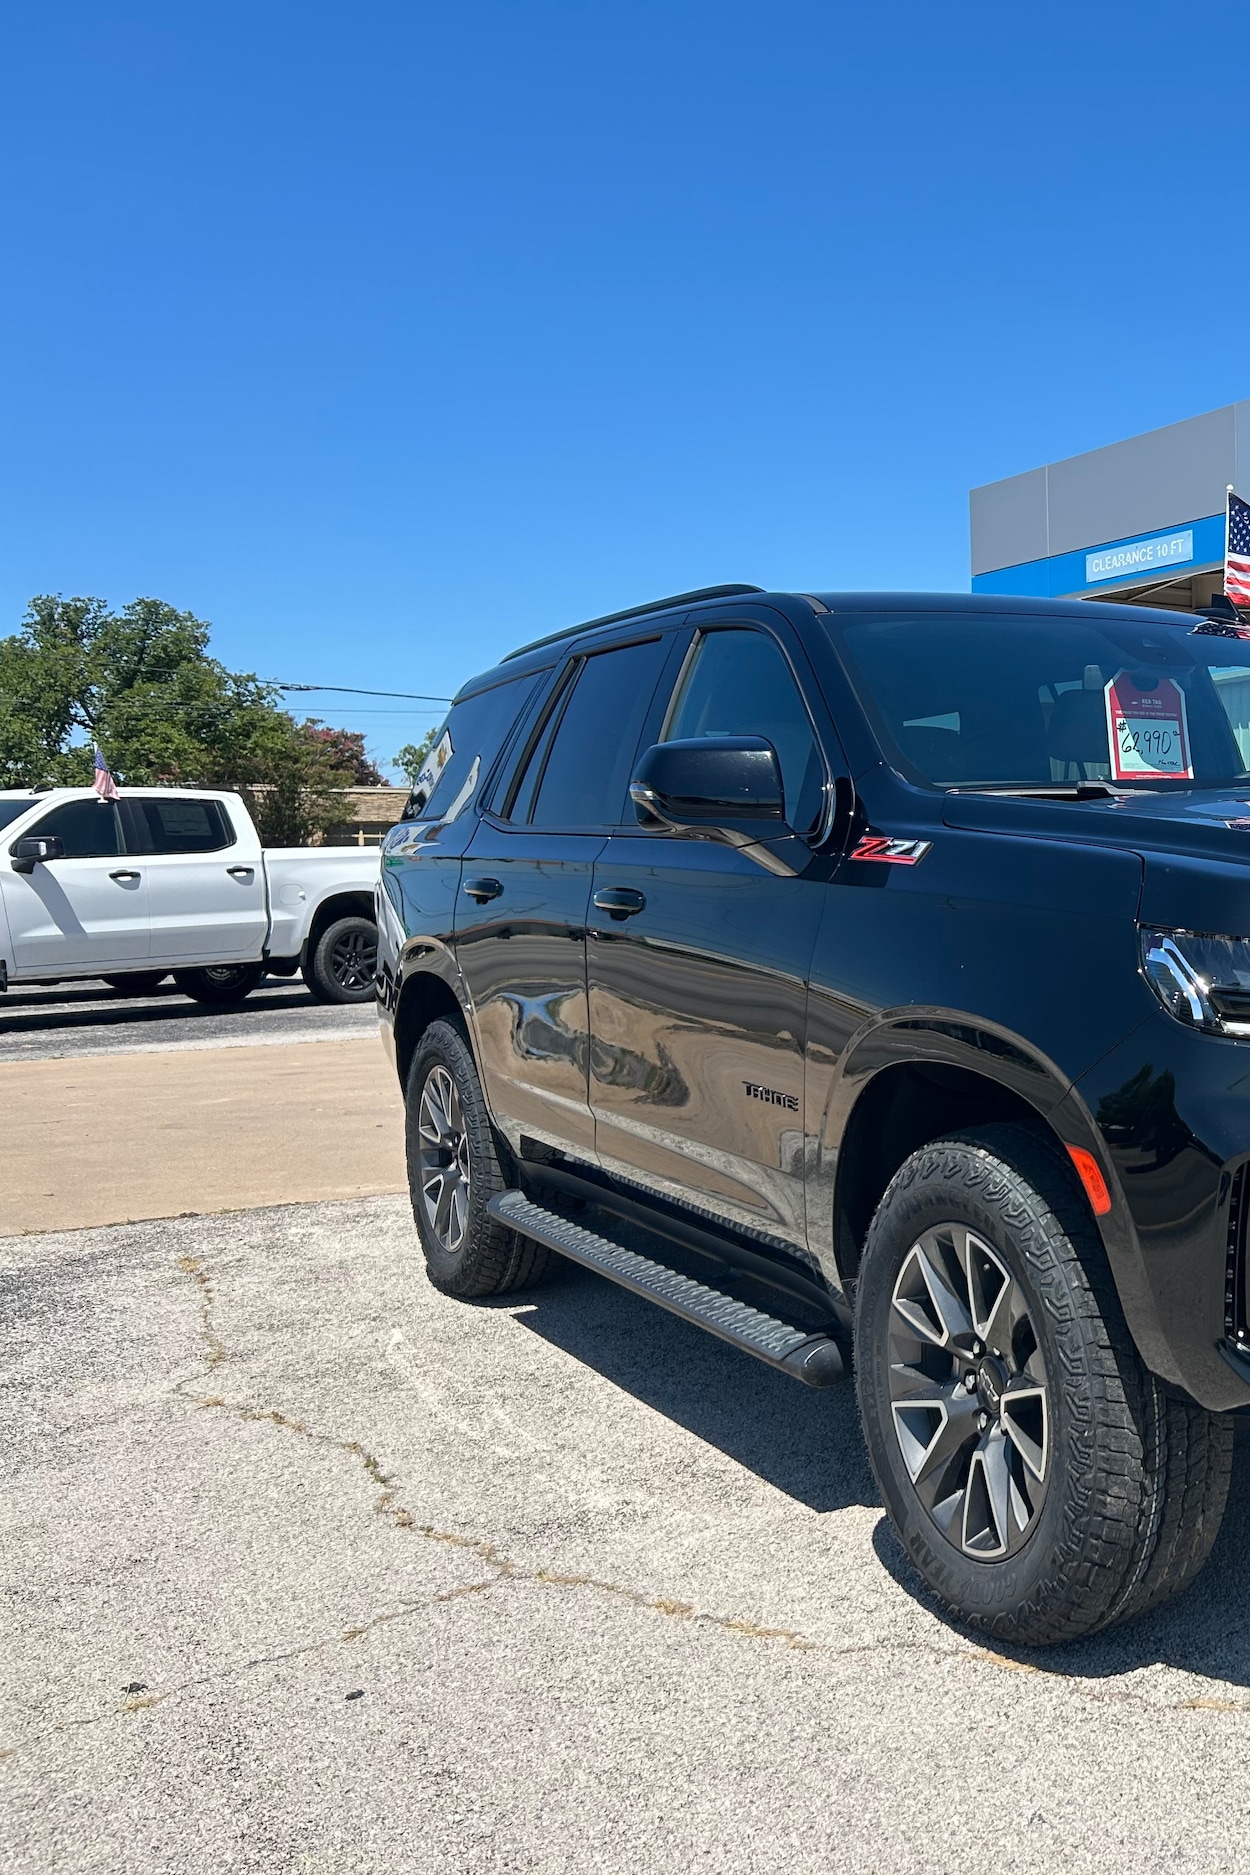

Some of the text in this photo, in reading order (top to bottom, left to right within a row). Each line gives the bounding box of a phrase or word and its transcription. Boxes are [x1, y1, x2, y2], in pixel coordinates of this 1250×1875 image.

[1092, 538, 1184, 573] CLEARANCE 10 FT
[848, 834, 934, 866] Z71
